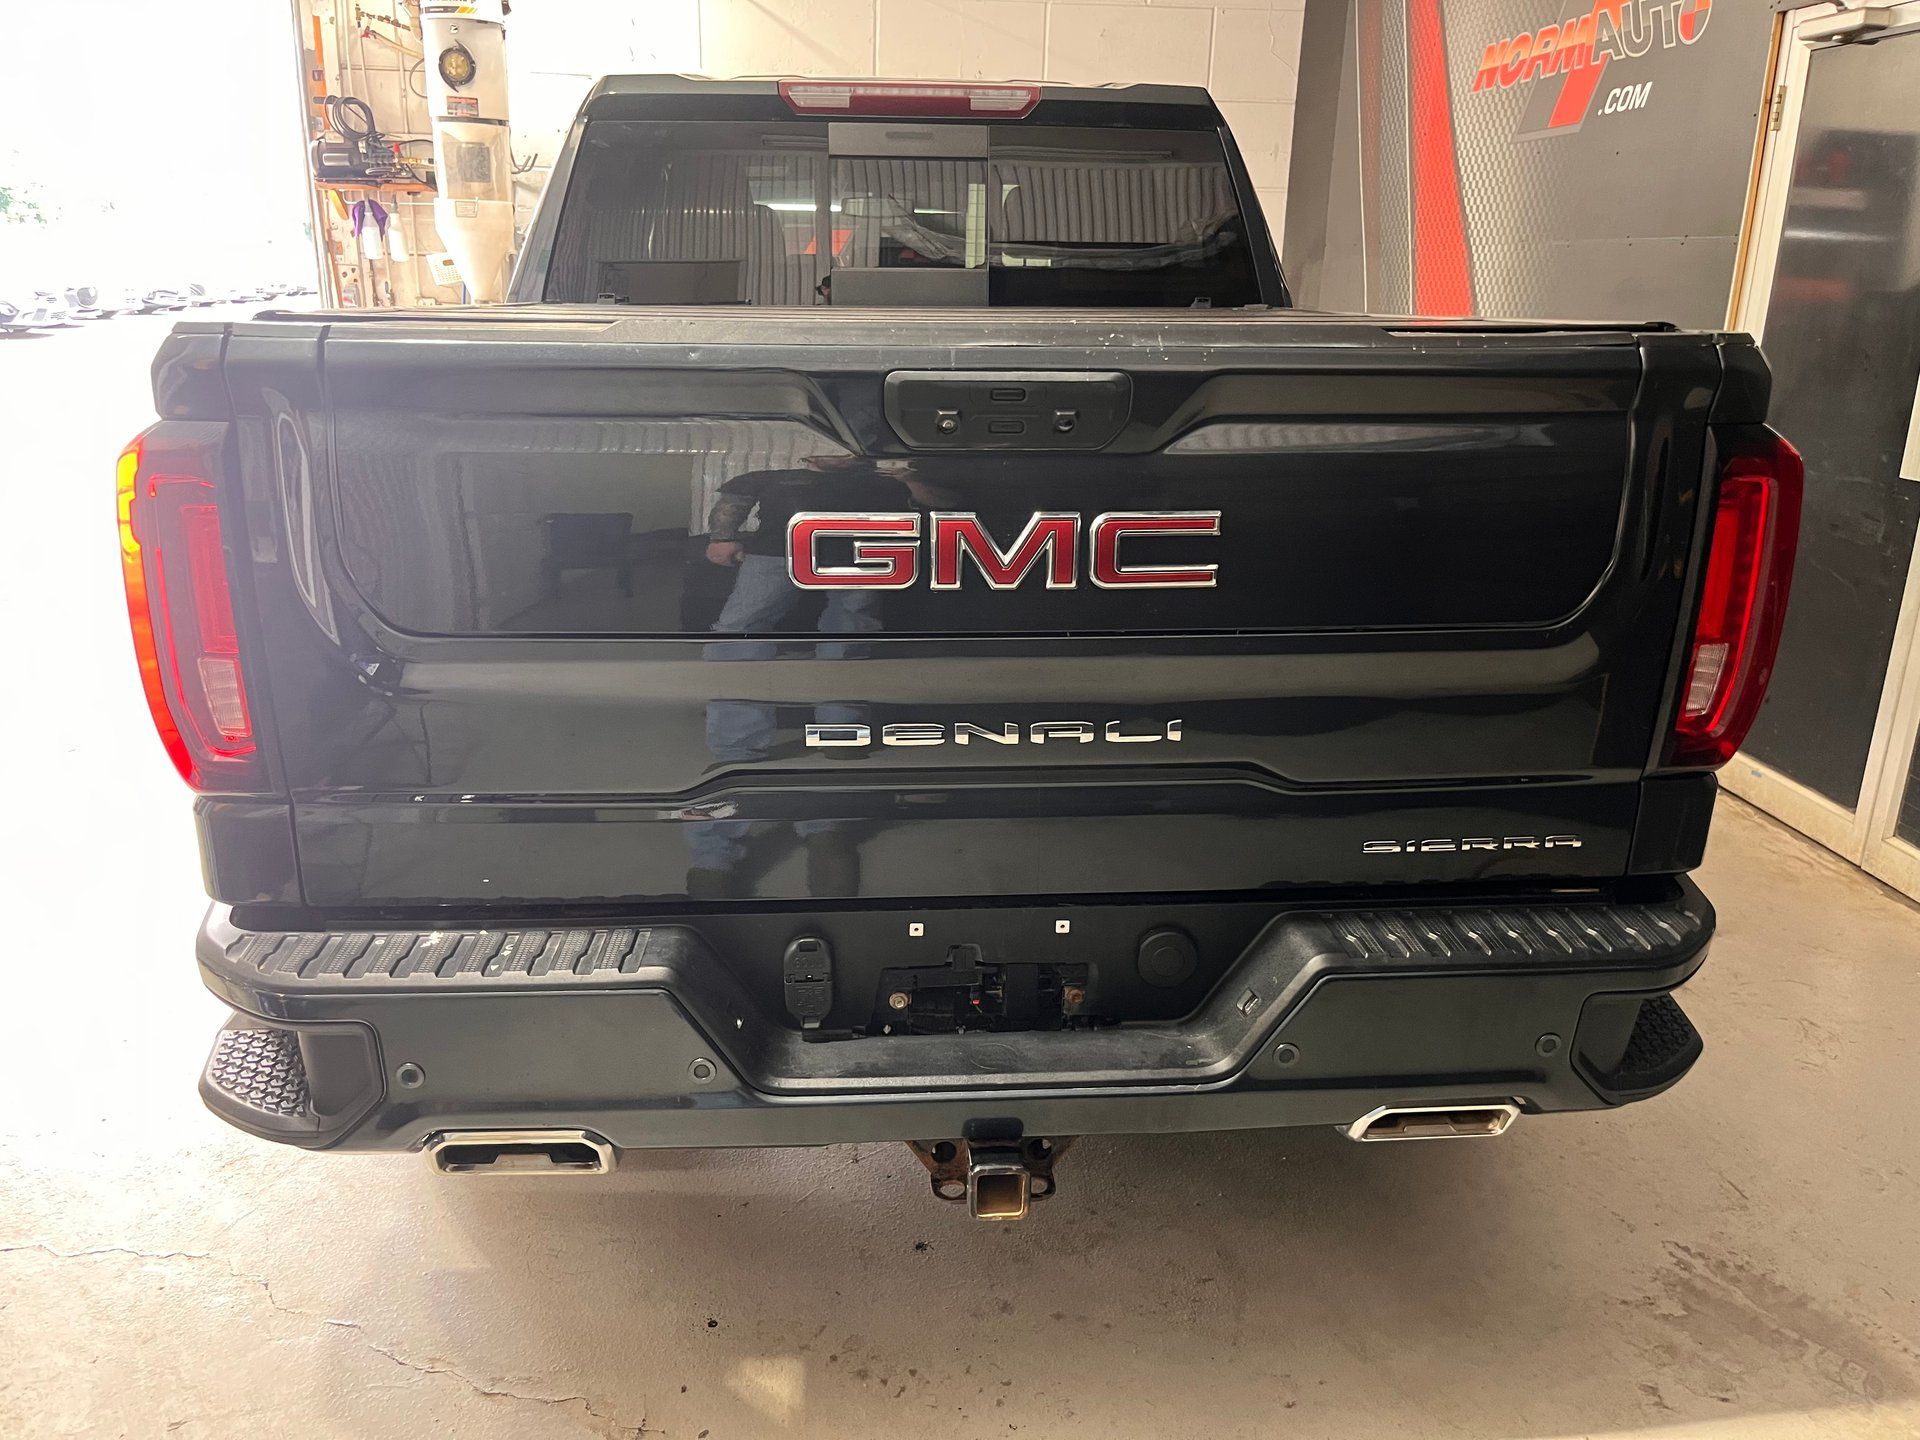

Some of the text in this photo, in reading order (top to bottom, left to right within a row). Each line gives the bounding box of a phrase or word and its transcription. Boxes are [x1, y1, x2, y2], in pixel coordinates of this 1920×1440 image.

[1597, 81, 1653, 116] .COM
[786, 510, 1222, 591] GMC
[804, 719, 1183, 747] DENALI
[1362, 834, 1583, 853] SIERRA
